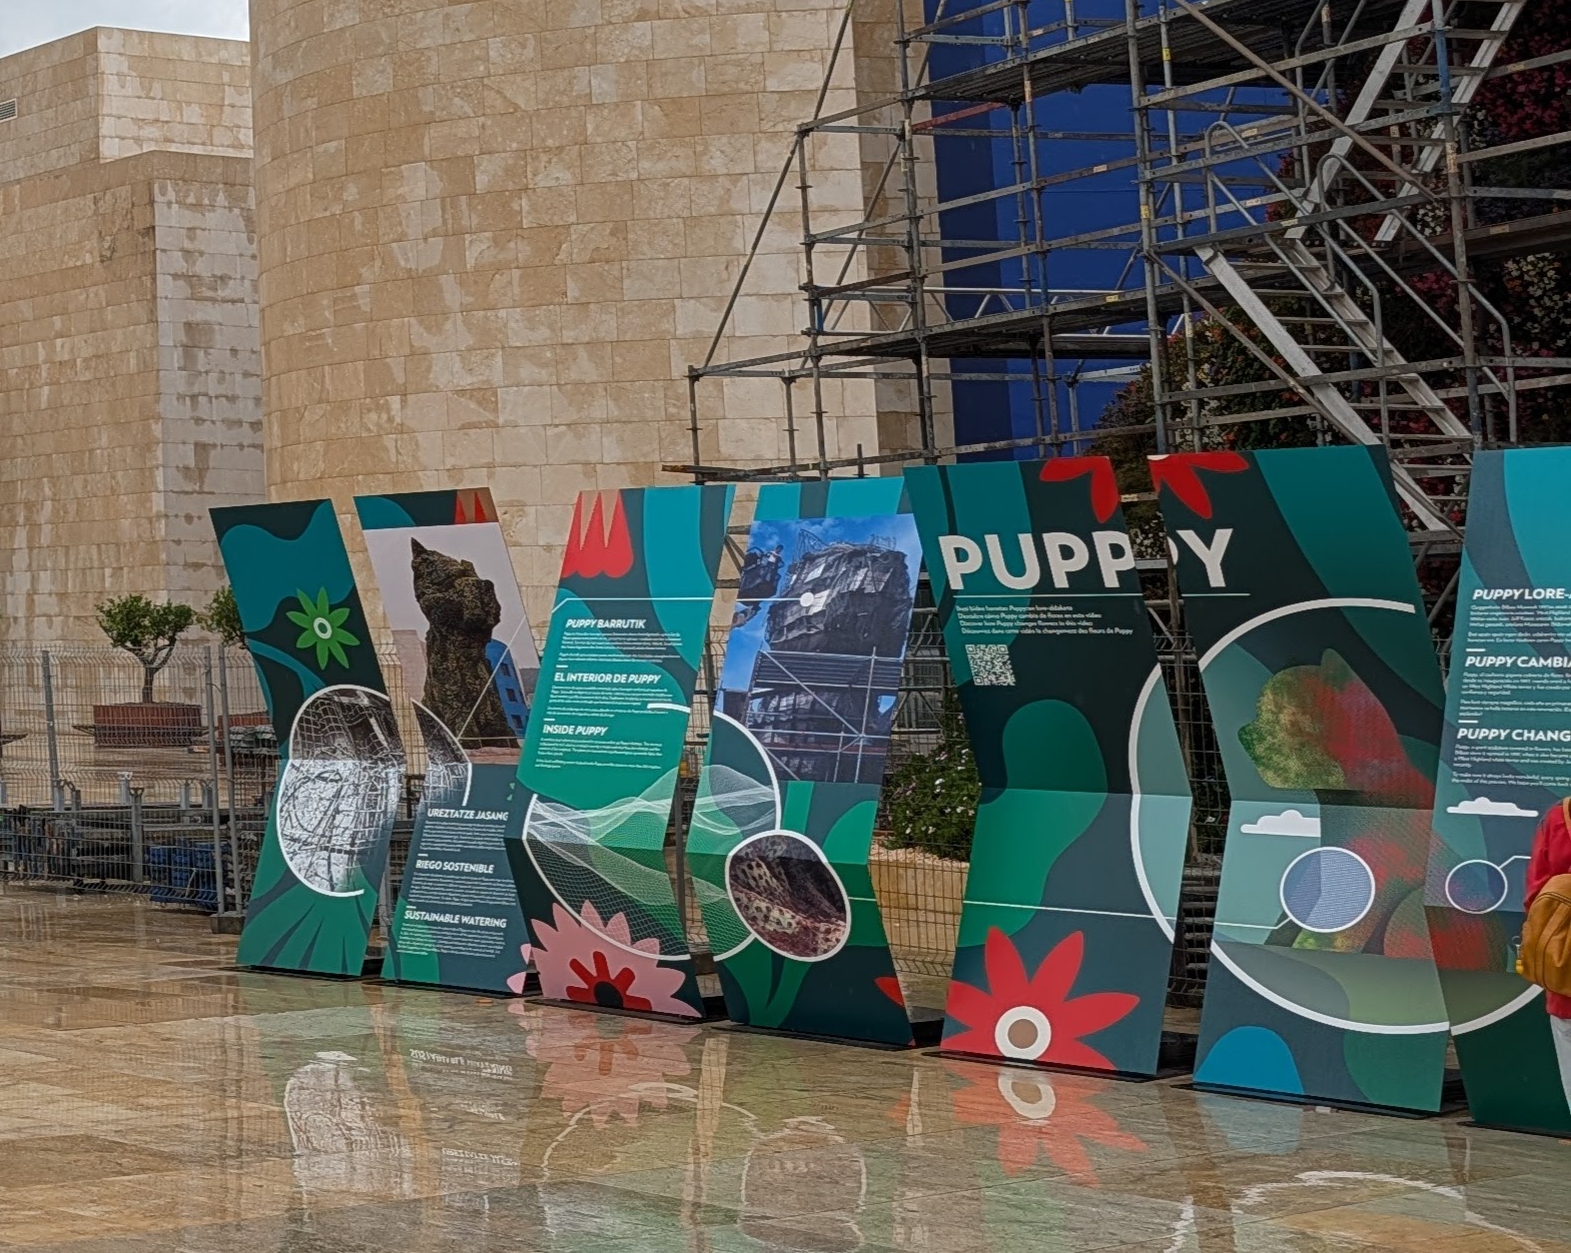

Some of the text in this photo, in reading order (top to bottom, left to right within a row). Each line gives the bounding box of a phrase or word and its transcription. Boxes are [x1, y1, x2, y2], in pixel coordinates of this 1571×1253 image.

[1472, 588, 1571, 600] PUPPY LORE-
[1000, 612, 1017, 620] Puppy
[565, 618, 647, 629] PUPPY BARRUTIK
[1114, 627, 1133, 635] Puppy
[1465, 656, 1517, 667] PUPPY
[554, 672, 662, 684] EL INTERIOR DE PUPPY
[542, 724, 609, 736] INSIDE PUPPY
[1456, 728, 1512, 740] PUPPY
[427, 808, 475, 820] UREZTATZE
[415, 859, 495, 874] RIEGO SOSTENIBLE
[404, 910, 507, 928] SUSTAINABLE WATERING
